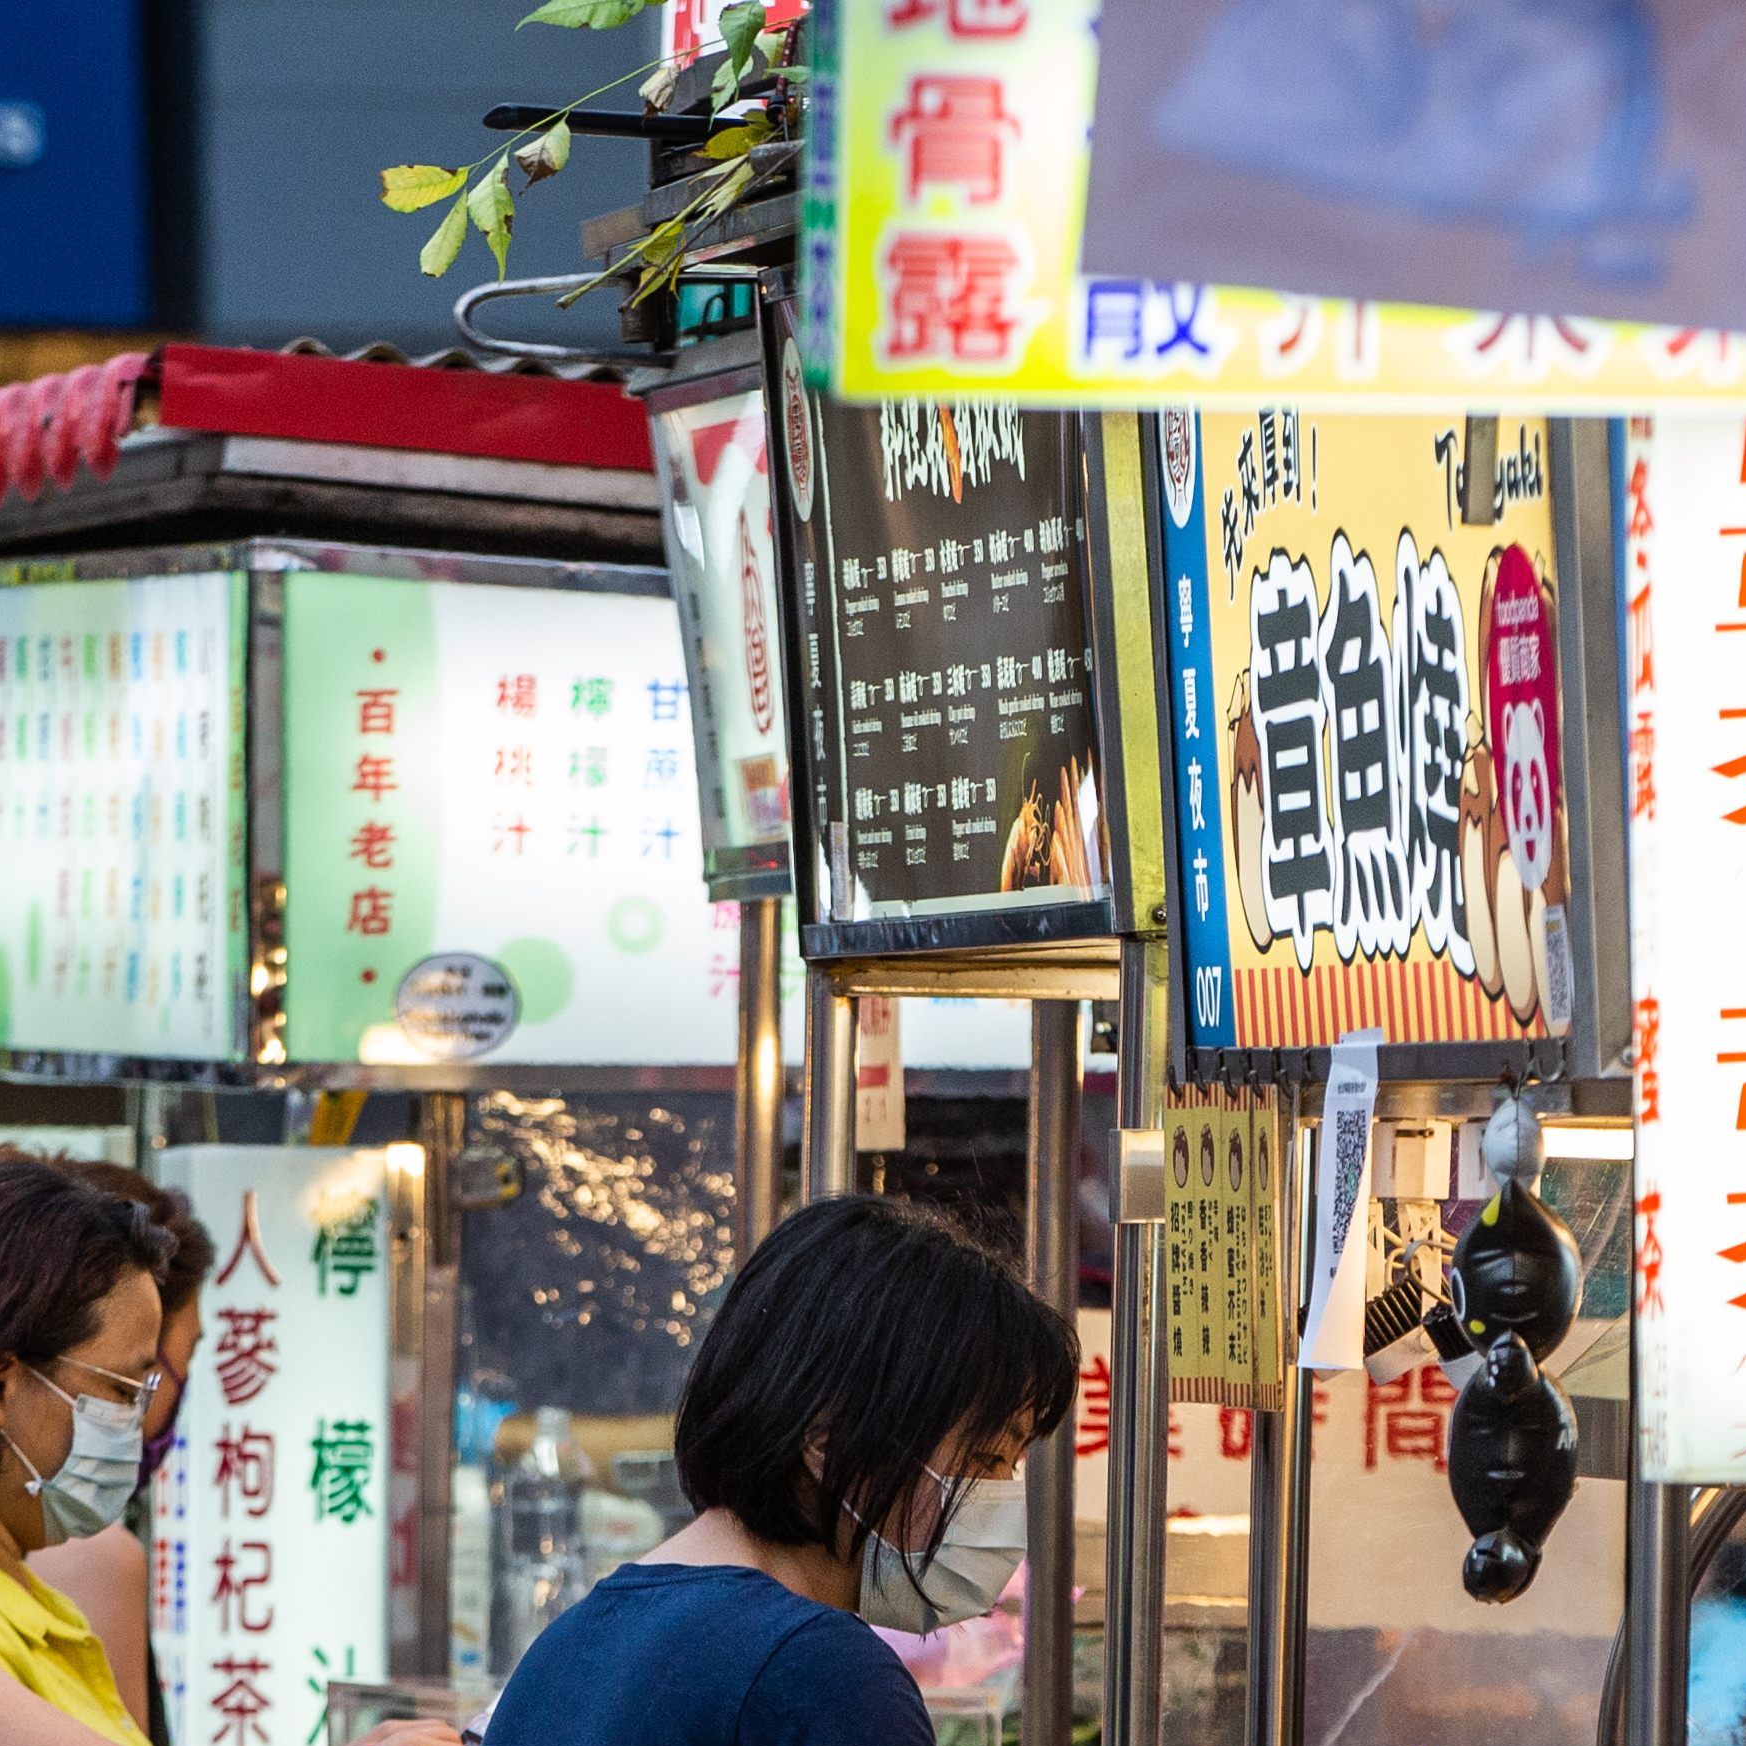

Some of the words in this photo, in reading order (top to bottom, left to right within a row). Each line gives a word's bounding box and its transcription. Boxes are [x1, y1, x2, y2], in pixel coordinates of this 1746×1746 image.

[345, 686, 401, 938] 百年老店
[491, 672, 539, 860] 楊桃汁
[565, 675, 615, 861] 檸檬汁
[1178, 573, 1210, 923] 寧夏夜市
[1196, 965, 1223, 1028] 007
[1200, 1199, 1210, 1357] 香香辣辣
[1227, 1205, 1236, 1362] 蜂蜜芥末
